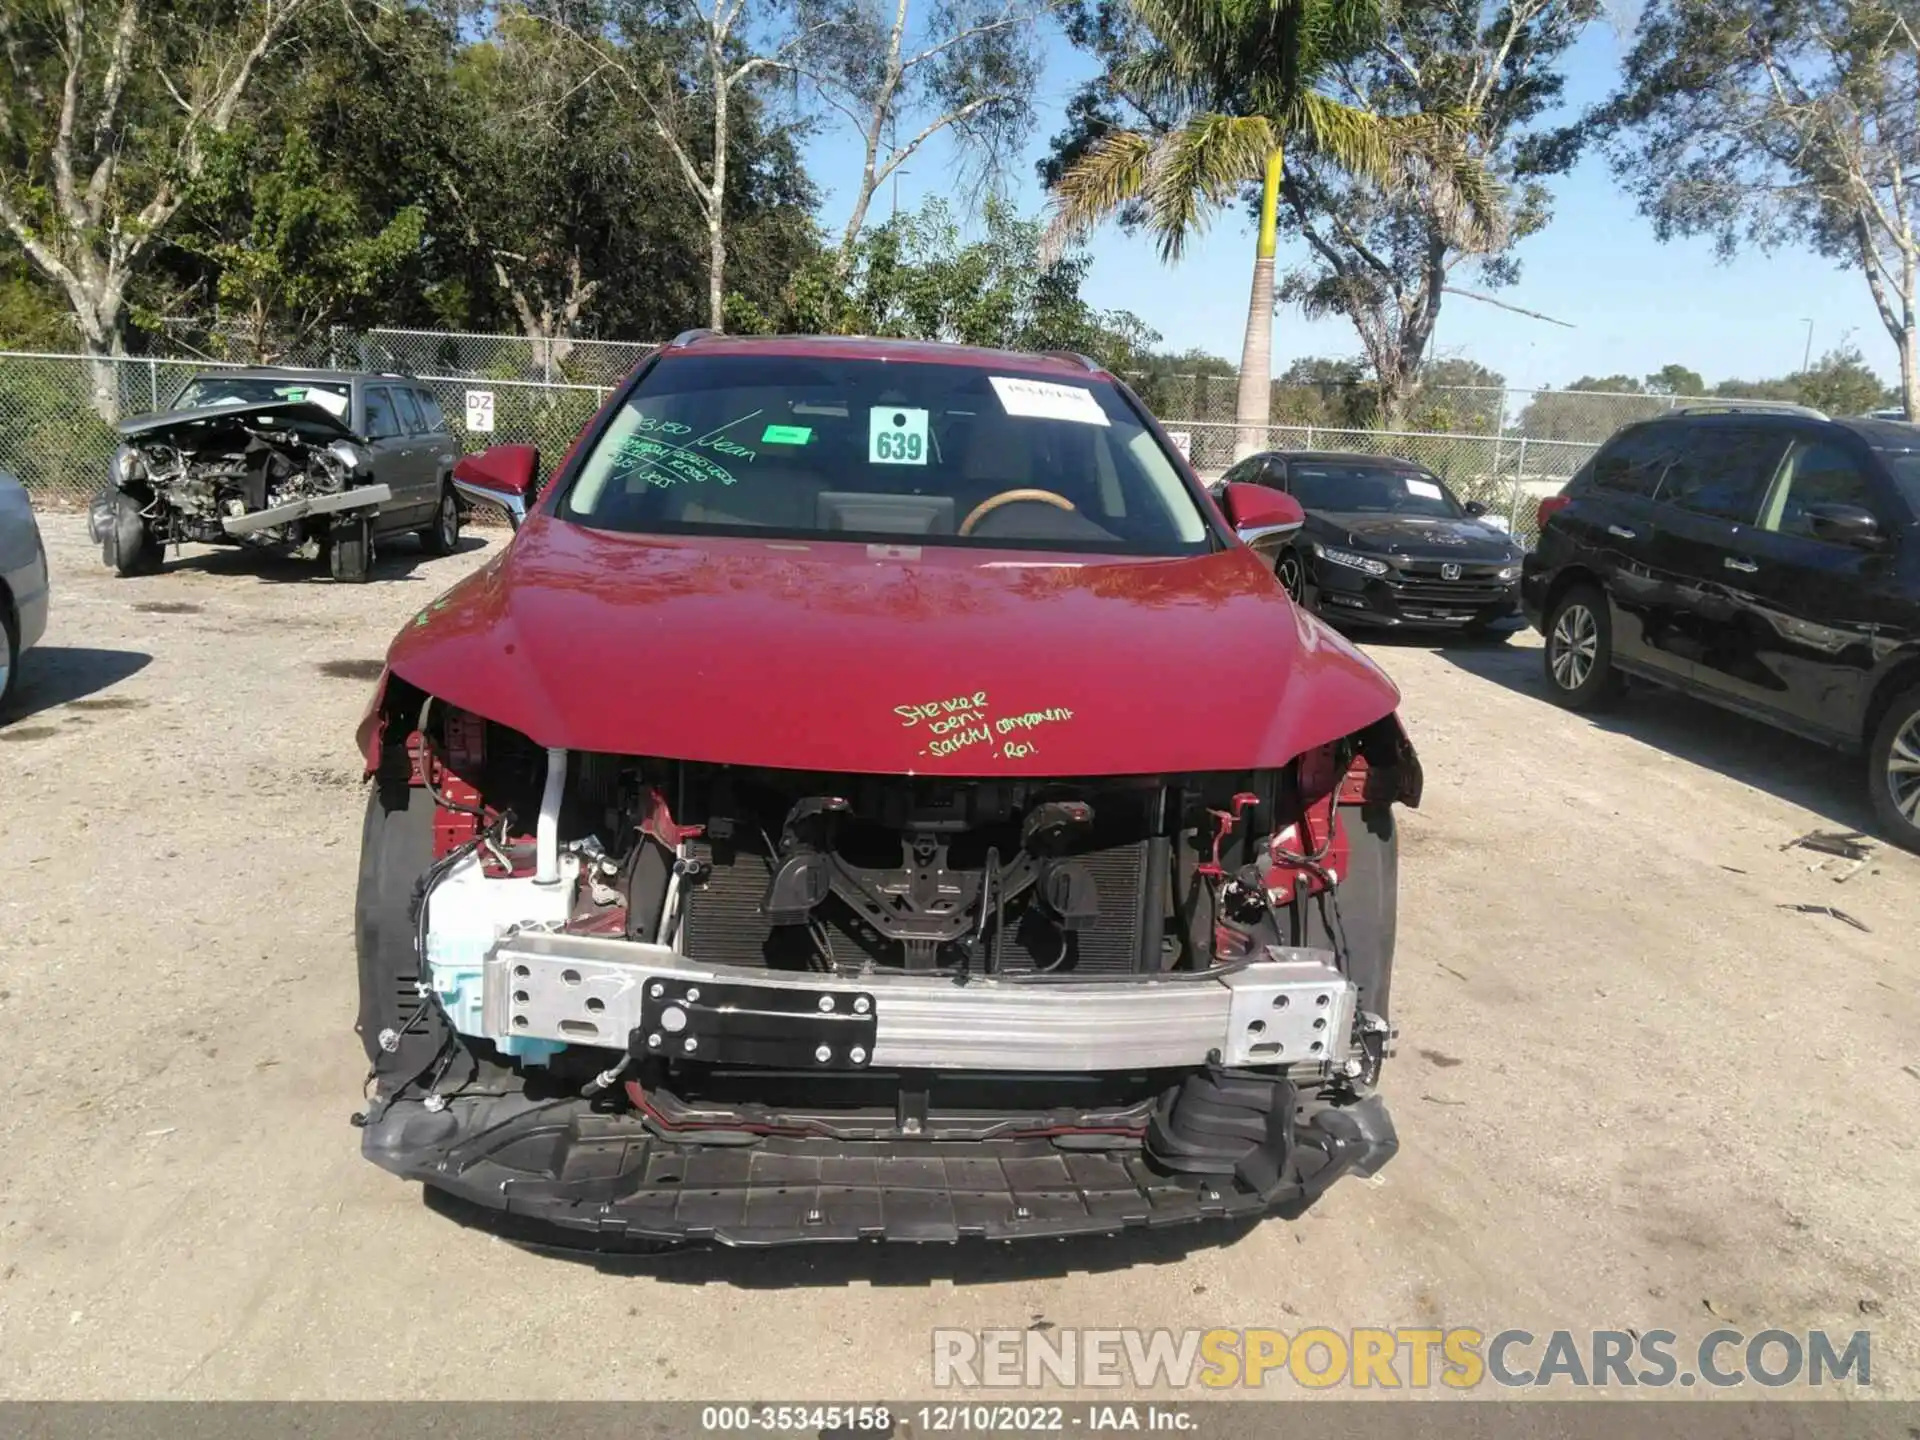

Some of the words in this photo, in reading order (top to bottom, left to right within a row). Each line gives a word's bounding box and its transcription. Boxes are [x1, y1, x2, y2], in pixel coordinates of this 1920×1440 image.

[468, 395, 492, 410] DZ
[475, 412, 485, 427] 2
[877, 431, 922, 461] 639
